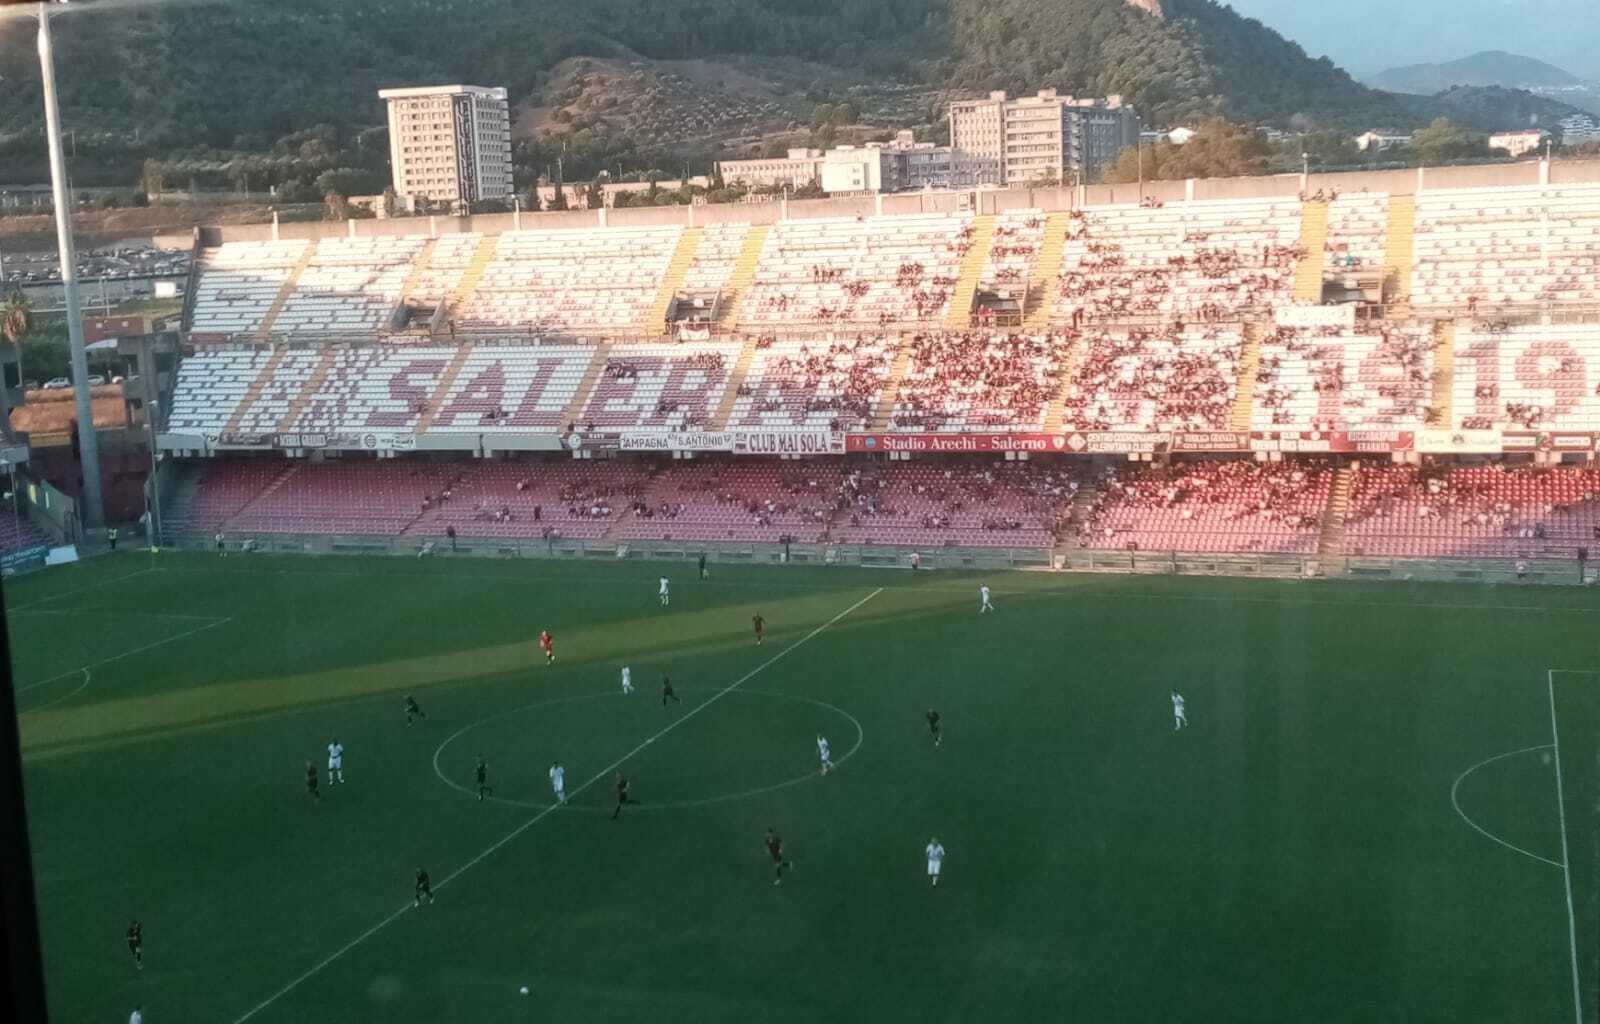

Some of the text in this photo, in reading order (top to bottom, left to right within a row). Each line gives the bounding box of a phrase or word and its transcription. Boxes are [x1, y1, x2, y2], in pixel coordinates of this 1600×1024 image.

[749, 434, 776, 452] CLUB
[779, 434, 798, 452] MAI
[801, 434, 828, 452] SOLA
[883, 436, 925, 450] Stadio
[932, 436, 976, 450] Arechi
[992, 436, 1046, 450] Salerno
